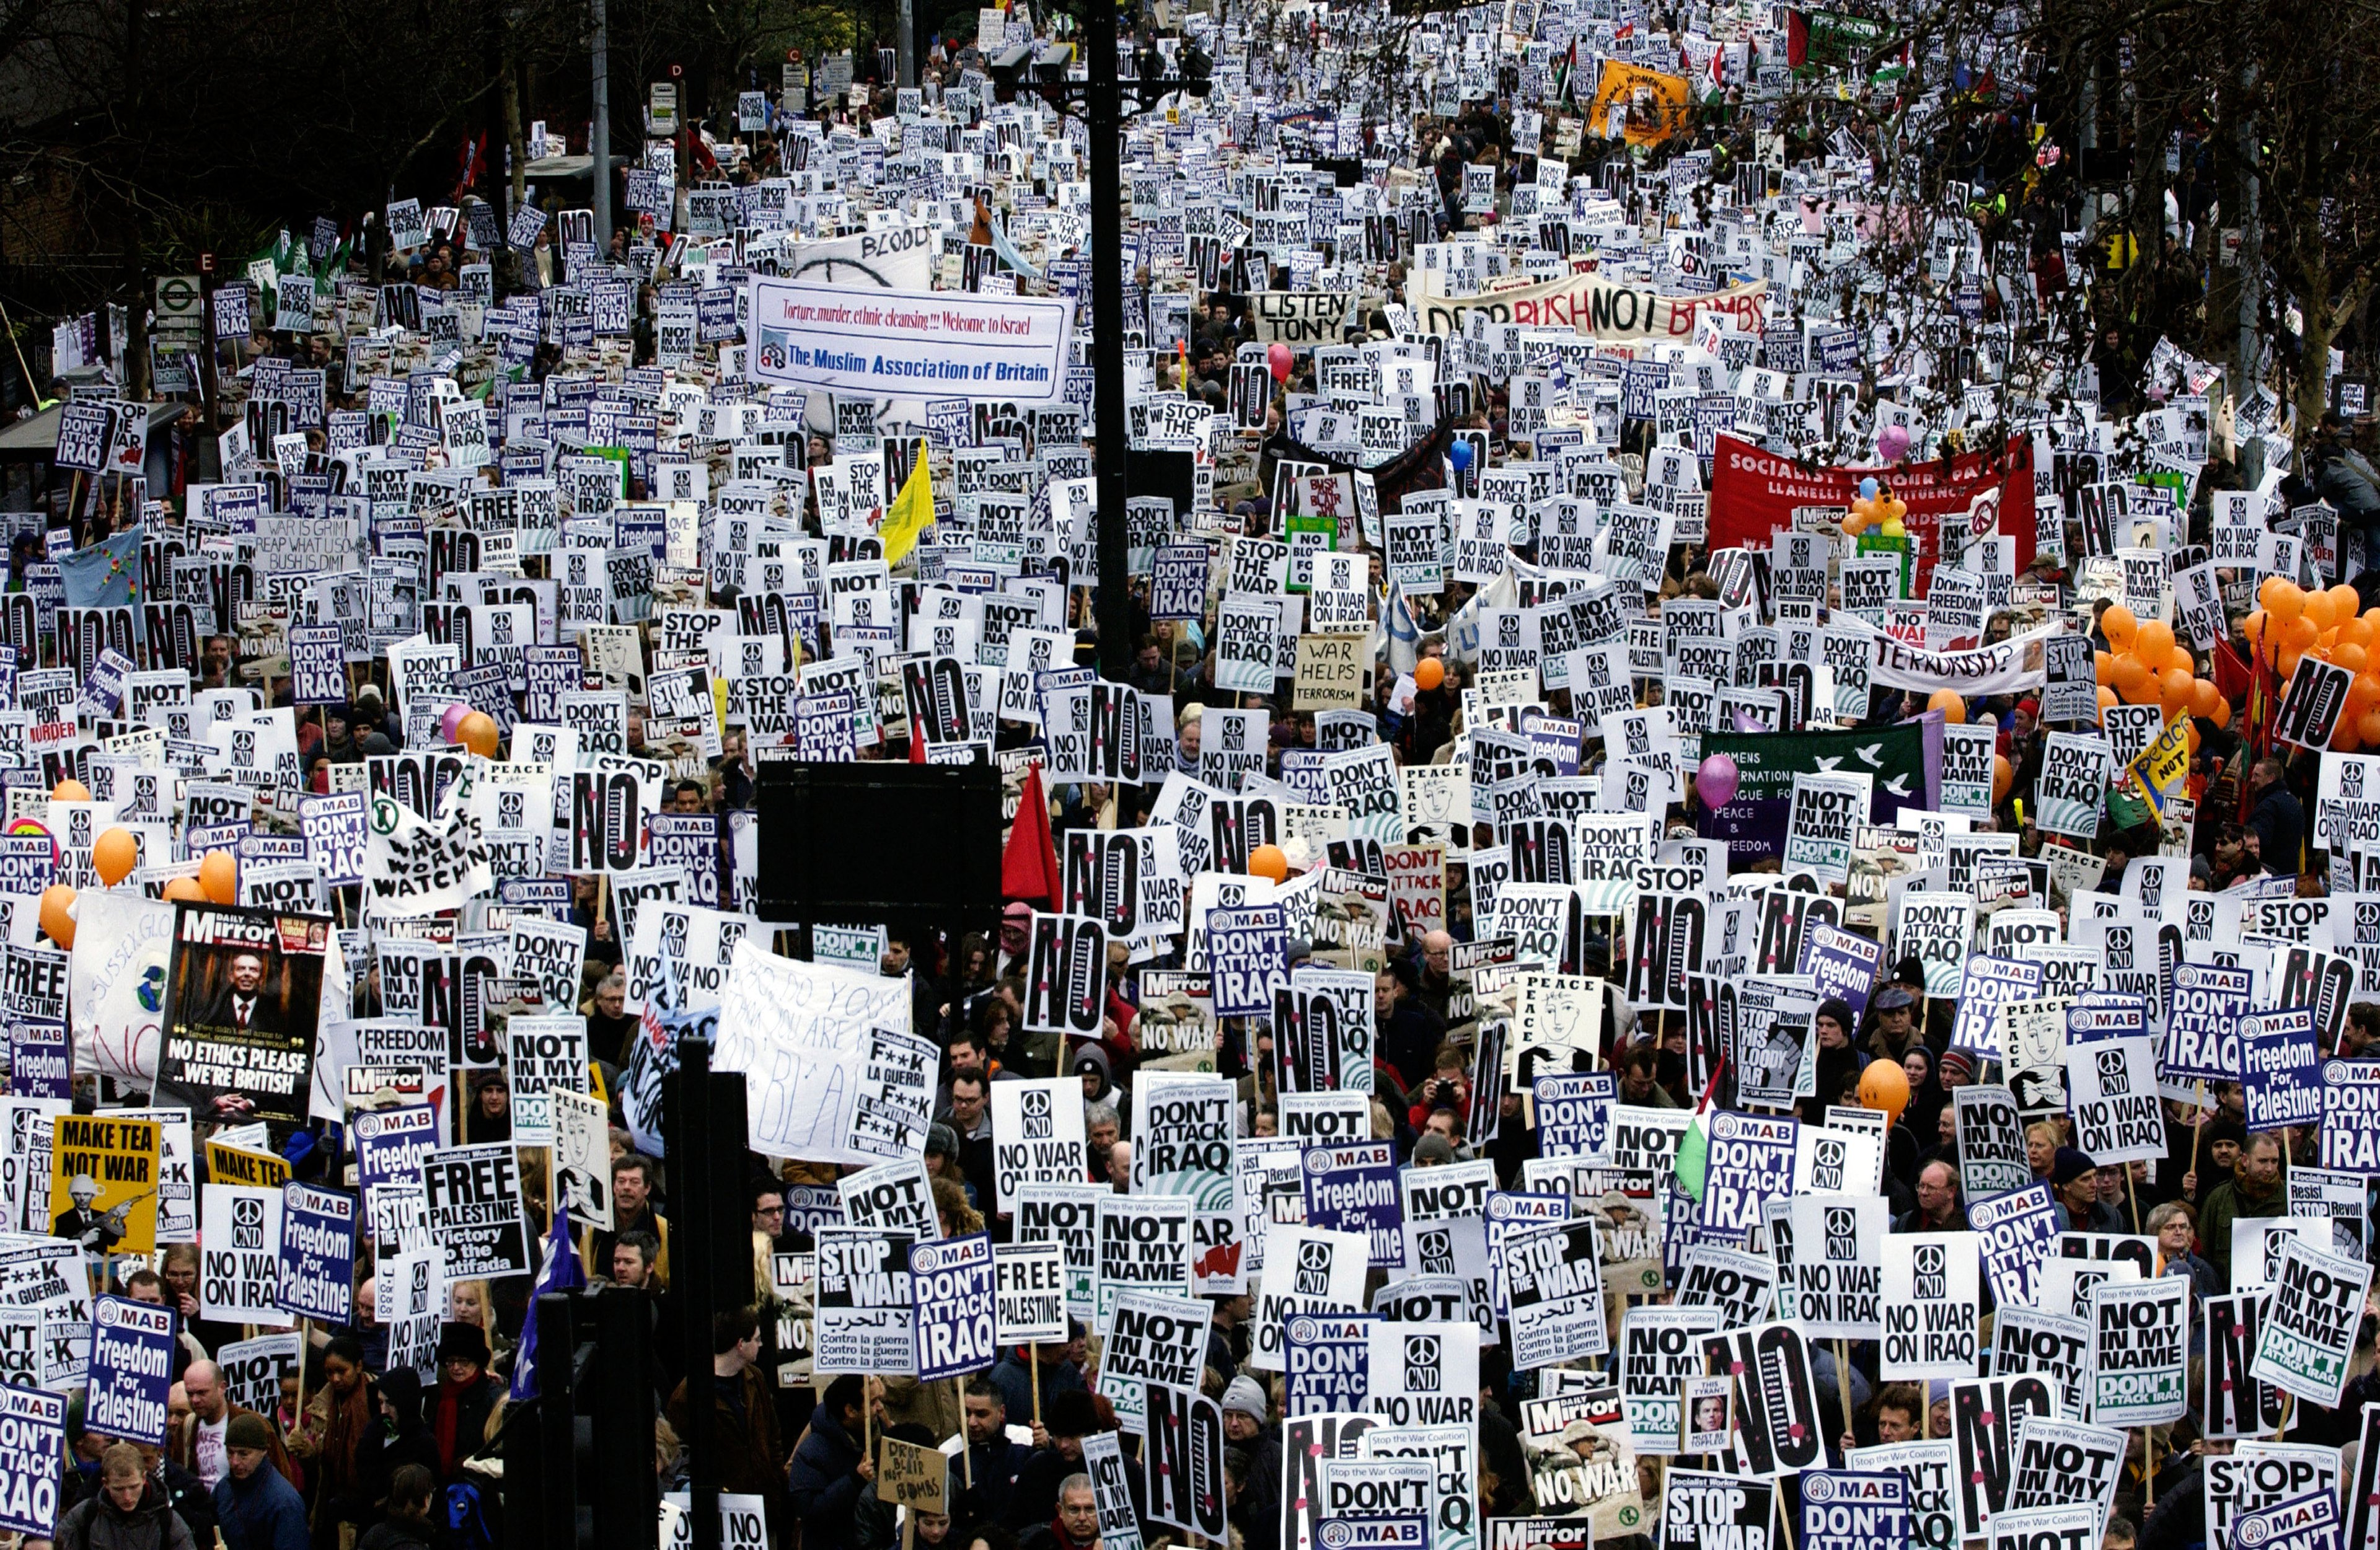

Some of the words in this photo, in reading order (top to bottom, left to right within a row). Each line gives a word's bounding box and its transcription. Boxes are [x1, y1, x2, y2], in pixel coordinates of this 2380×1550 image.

[791, 51, 799, 61] C
[673, 65, 681, 76] D
[1626, 74, 1666, 94] WOMEN'S
[1186, 222, 1215, 234] IRAQ
[201, 253, 213, 270] E
[214, 297, 247, 310] DON'T
[1260, 294, 1347, 317] LISTEN
[216, 315, 250, 335] IRAQ
[853, 306, 883, 327] ethnic
[884, 309, 928, 330] cleansing
[943, 310, 985, 333] Welcome
[989, 317, 999, 333] to
[999, 315, 1030, 335] Israel
[1264, 319, 1339, 342] TONY
[788, 345, 810, 366] The
[814, 349, 866, 372] Muslim
[873, 355, 969, 379] Association
[972, 362, 991, 380] of
[996, 363, 1049, 382] Britain
[449, 430, 484, 446] IRAQ
[1730, 453, 1835, 485] SOCIALIST
[1310, 478, 1338, 490] BUSH
[1768, 481, 1841, 501] LLANELLI
[1850, 487, 1967, 501] CTITUENCY
[1310, 493, 1341, 506] BLAIR
[1675, 506, 1704, 519] FREE
[268, 520, 295, 535] WAR
[299, 520, 310, 535] IS
[314, 519, 348, 537] GRIM!
[1674, 520, 1704, 534] PALESTINE
[256, 537, 286, 552] REAP
[289, 537, 322, 553] WHAT
[325, 537, 333, 553] U
[1235, 539, 1288, 560] STOP
[1300, 535, 1321, 544] NO
[270, 553, 302, 570] BUSH
[305, 557, 316, 570] IS
[320, 555, 343, 571] DIM!
[2125, 560, 2161, 576] NOT
[1232, 575, 1278, 594] WAR
[2126, 586, 2161, 599] NAME
[372, 603, 408, 616] BLOODY
[1152, 592, 1204, 615] IRAQ
[1929, 593, 1982, 611] FREEDOM
[1928, 610, 1982, 628] PALESTINE
[292, 643, 343, 661] DON'T
[1308, 641, 1352, 661] WAR
[1301, 663, 1355, 680] HELPS
[295, 675, 345, 700] IRAQ
[1296, 687, 1355, 702] TERRORISM
[20, 687, 73, 710] WANTED
[2278, 658, 2350, 747] NO
[36, 706, 60, 724] FOR
[2107, 707, 2161, 728] STOP
[30, 722, 76, 744] MURDER
[1406, 767, 1462, 778] PEACE
[2159, 750, 2185, 780] NOT
[2340, 781, 2362, 798] CND
[1798, 788, 1856, 812] NOT
[573, 772, 640, 870] NO
[1714, 808, 1754, 819] PEACE
[669, 817, 714, 832] MAB
[1793, 822, 1852, 841] NAME
[182, 909, 275, 944] Mirror
[216, 912, 244, 923] DAILY
[1527, 977, 1594, 990] PEACE
[2263, 1014, 2310, 1033] MAB
[364, 1029, 445, 1051] FREEDOM
[513, 1034, 581, 1059] NOT
[168, 1039, 192, 1059] NO
[195, 1041, 247, 1067] ETHICS
[249, 1047, 307, 1074] PLEASE
[2244, 1039, 2315, 1073] Freedom
[234, 1068, 294, 1095] BRITISH
[867, 1065, 880, 1081] LA
[884, 1070, 925, 1089] GUERRA
[555, 1093, 598, 1116] PEACE
[2247, 1084, 2320, 1119] Palestine
[870, 1098, 928, 1135] CAPITALISMO
[2078, 1103, 2108, 1129] NO
[2112, 1096, 2158, 1123] WAR
[63, 1121, 115, 1148] MAKE
[119, 1124, 153, 1151] TEA
[2082, 1127, 2114, 1152] ON
[2117, 1122, 2162, 1150] IRAQ
[63, 1151, 100, 1177] NOT
[105, 1158, 149, 1182] WAR
[425, 1159, 515, 1203] FREE
[429, 1200, 520, 1226] PALESTINE
[434, 1226, 503, 1245] Victory
[821, 1241, 891, 1275] STOP
[997, 1262, 1061, 1291] FREE
[822, 1275, 847, 1293] THE
[850, 1271, 912, 1307] WAR
[120, 1307, 169, 1331] MAB
[895, 1310, 911, 1329] لا
[998, 1297, 1062, 1326] PALESTINE
[2099, 1299, 2181, 1331] NOT
[819, 1333, 857, 1345] Contra
[860, 1334, 870, 1345] la
[873, 1335, 909, 1348] guerra
[920, 1318, 994, 1370] IRAQ
[94, 1329, 168, 1375] Freedom
[1693, 1386, 1726, 1396] TYRANT
[1701, 1381, 1719, 1389] THIS
[86, 1386, 166, 1436] Palestine
[1558, 1394, 1587, 1409] DAILY
[1531, 1398, 1620, 1435] Mirror
[84, 1423, 162, 1445] www.mabonline.net
[1690, 1437, 1726, 1448] TOPPLED!
[1691, 1433, 1712, 1442] MUST
[889, 1445, 921, 1461] DROP
[884, 1469, 903, 1482] NOT
[894, 1458, 924, 1476] BLAIR
[1330, 1466, 1350, 1477] Stop
[1352, 1468, 1367, 1476] the
[1369, 1468, 1387, 1476] War
[1389, 1466, 1428, 1476] Coalition
[897, 1479, 940, 1501] BOMBS
[1534, 1471, 1574, 1507] NO
[1577, 1460, 1639, 1499] WAR
